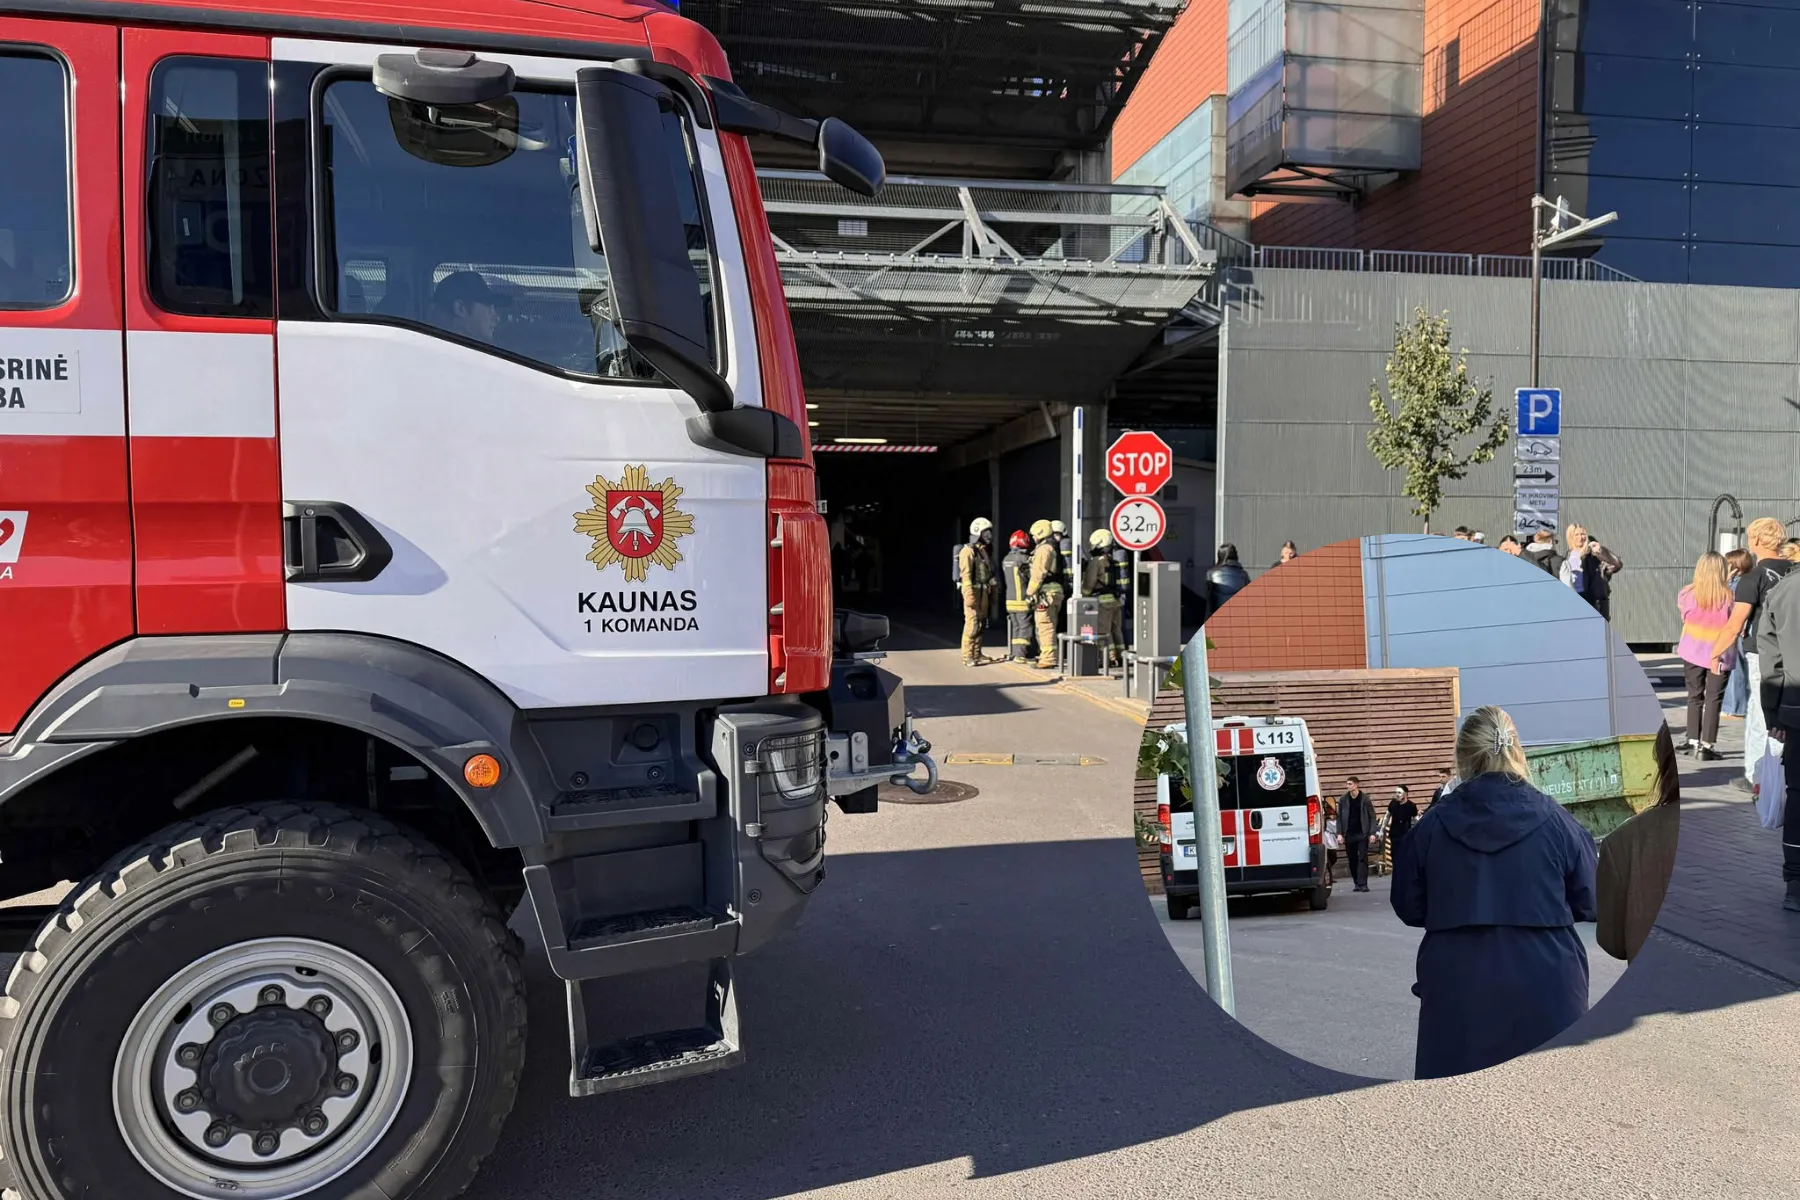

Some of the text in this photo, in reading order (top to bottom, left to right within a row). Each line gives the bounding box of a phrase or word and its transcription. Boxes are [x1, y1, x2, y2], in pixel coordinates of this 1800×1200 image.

[1529, 394, 1553, 430] P
[1112, 452, 1167, 477] STOP
[1523, 465, 1542, 473] 23m
[1120, 516, 1158, 534] 3,2m
[578, 590, 697, 614] KAUNAS
[584, 617, 699, 633] 1 KOMANDA
[1267, 731, 1294, 745] 113
